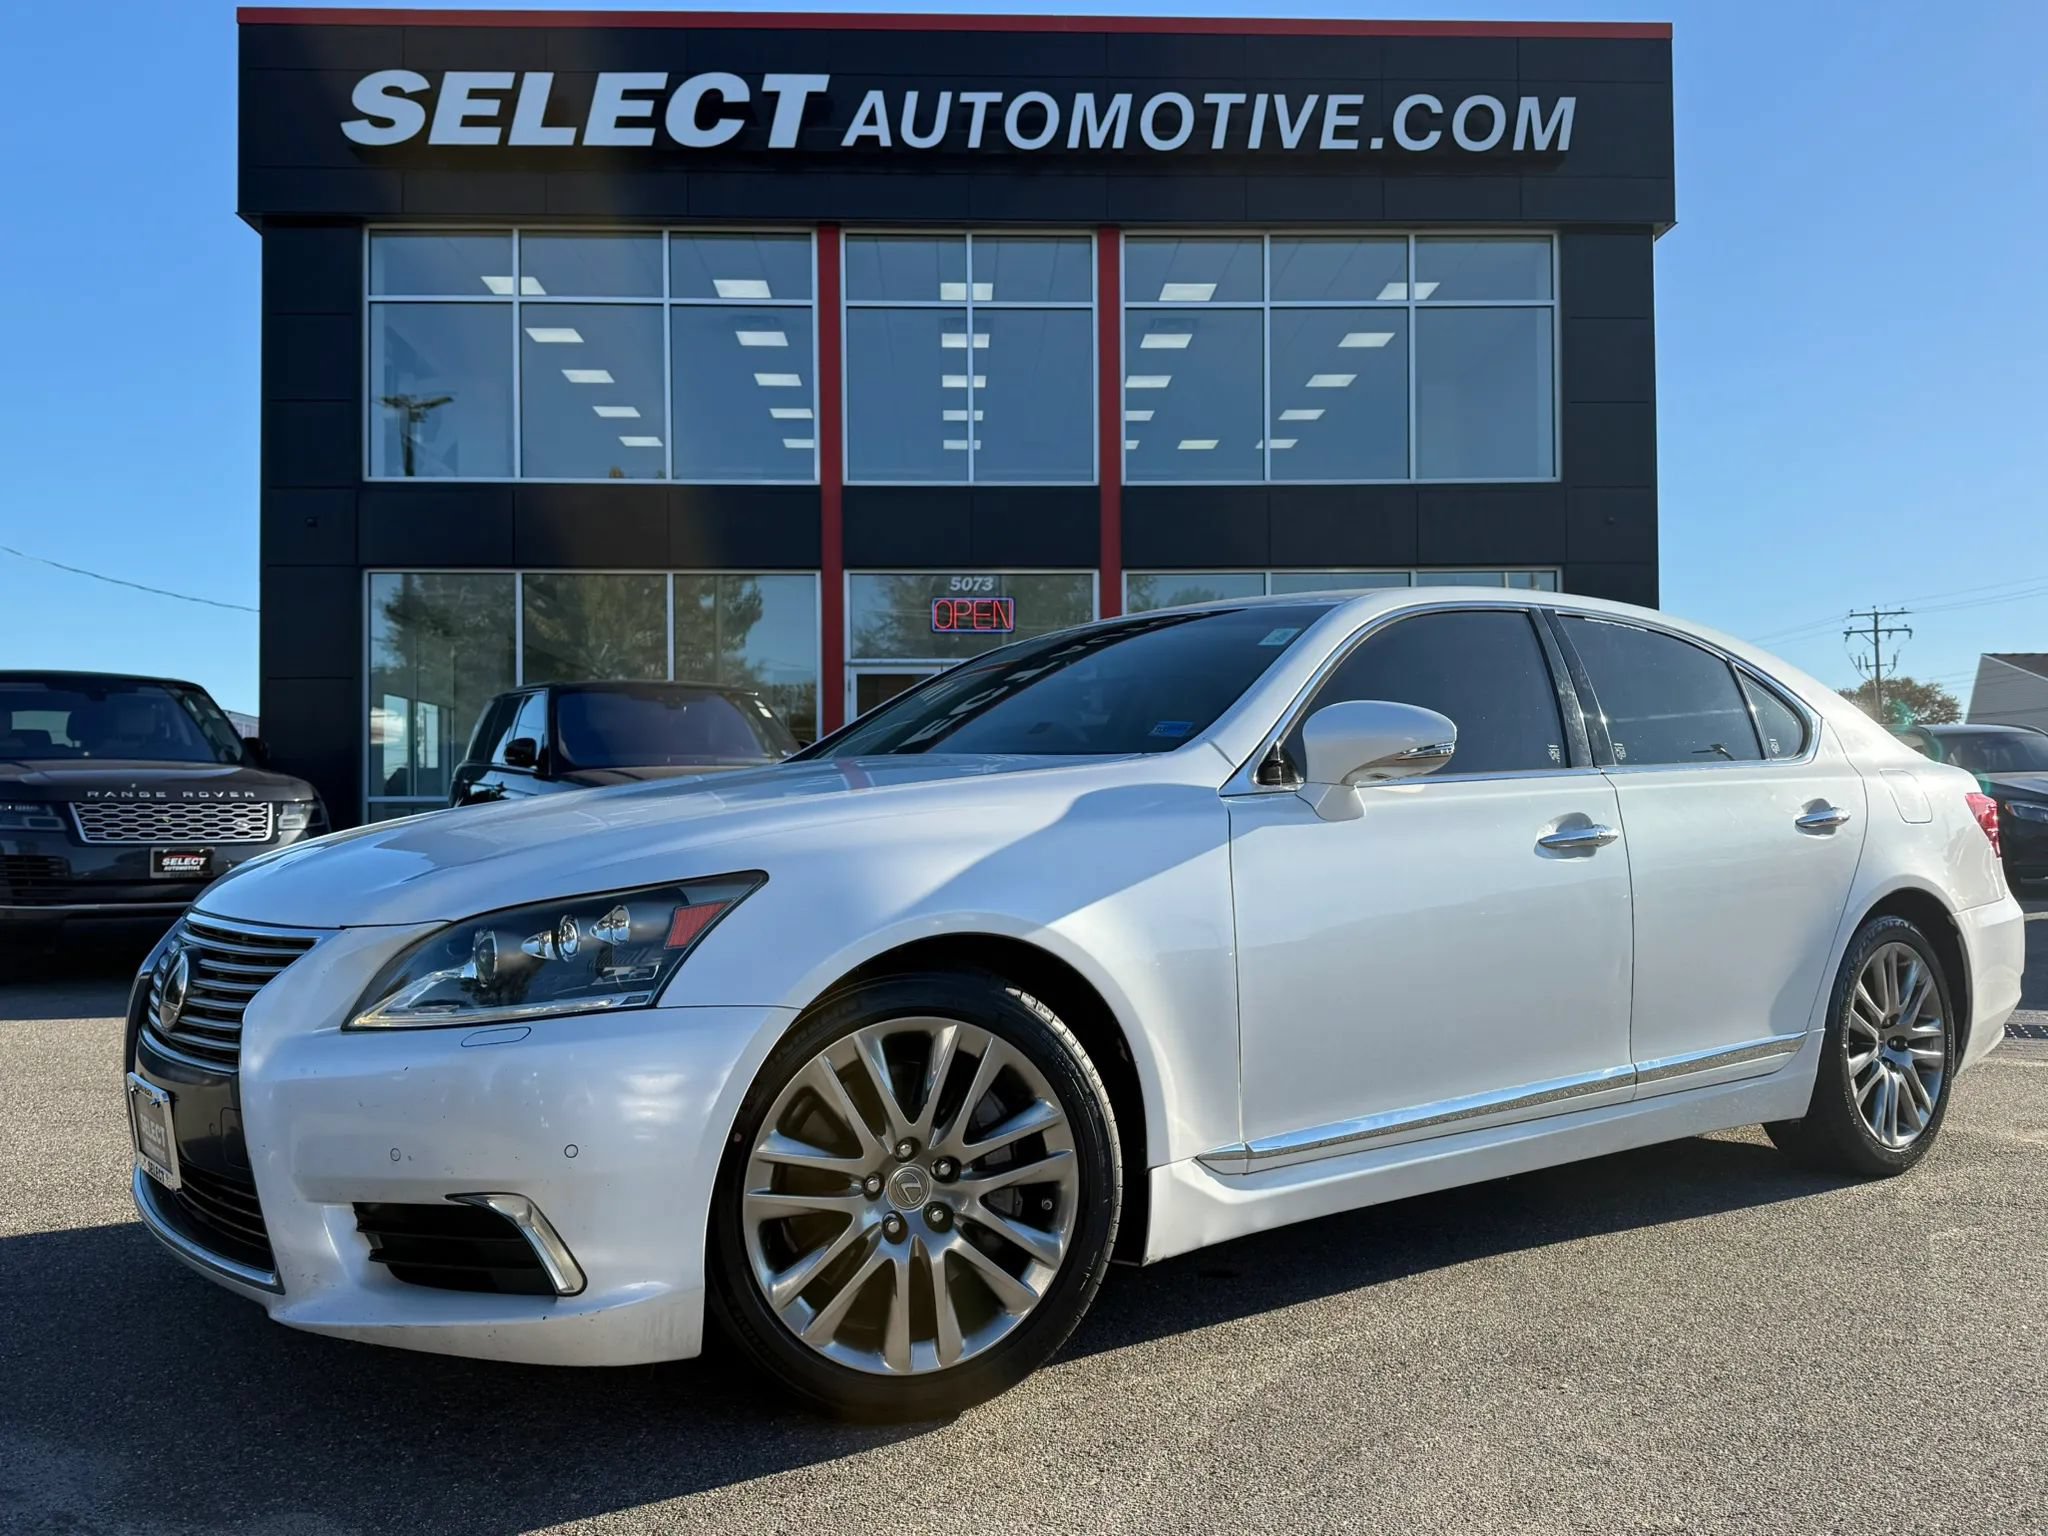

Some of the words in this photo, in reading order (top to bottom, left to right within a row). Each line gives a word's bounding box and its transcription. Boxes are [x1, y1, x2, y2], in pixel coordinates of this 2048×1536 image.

[340, 69, 831, 148] SELECT
[841, 90, 1577, 152] AUTOMOTIVE.COM
[950, 576, 994, 591] 5073
[934, 600, 1013, 629] OPEN
[161, 857, 206, 867] SELECT
[140, 1112, 166, 1148] SELECT
